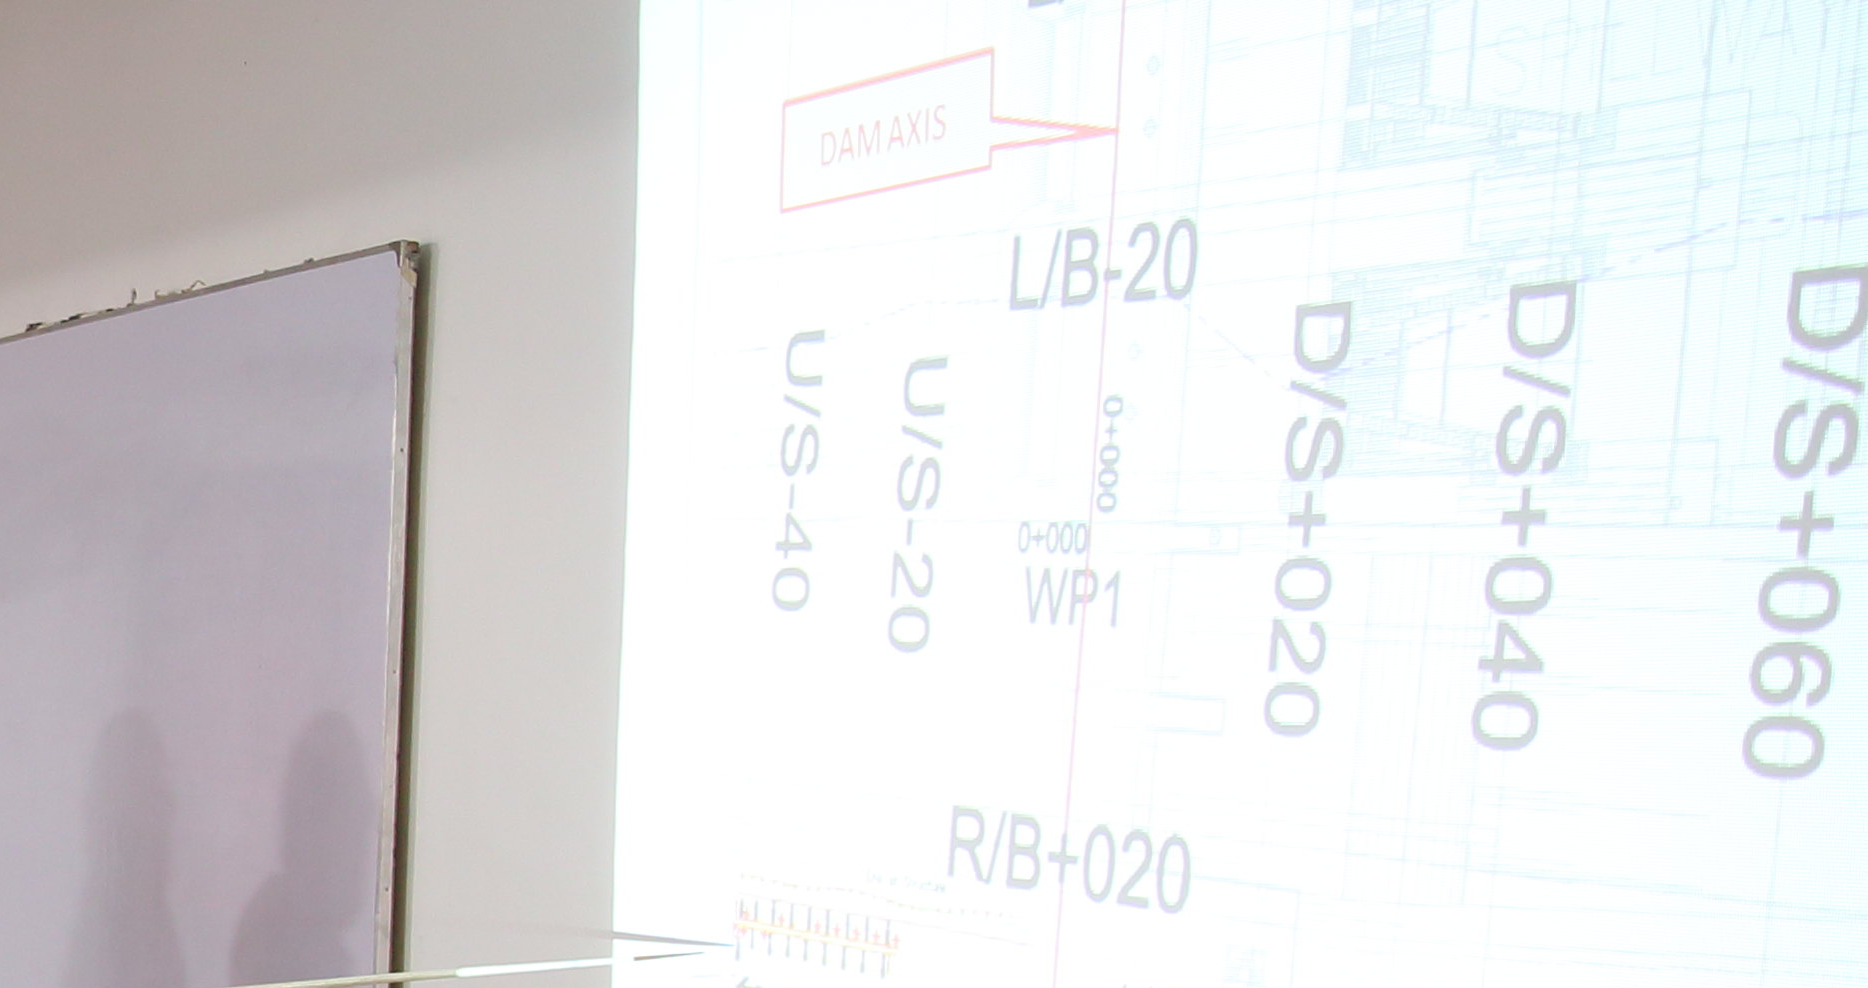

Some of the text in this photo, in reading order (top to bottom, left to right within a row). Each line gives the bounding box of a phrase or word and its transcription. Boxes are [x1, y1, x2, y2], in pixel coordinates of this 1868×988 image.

[820, 104, 948, 167] DAM AXIS
[1008, 216, 1199, 311] L/B-20
[771, 328, 826, 613] U/S-40
[887, 353, 949, 654] U/S-20
[1095, 393, 1125, 514] 0+000
[1017, 519, 1090, 555] 0+000
[1263, 300, 1354, 738] D/S+020
[1470, 278, 1578, 753] D/S+040
[1740, 262, 1868, 781] D/S+060
[1024, 565, 1122, 629] WP1
[946, 803, 1192, 914] R/B+020
